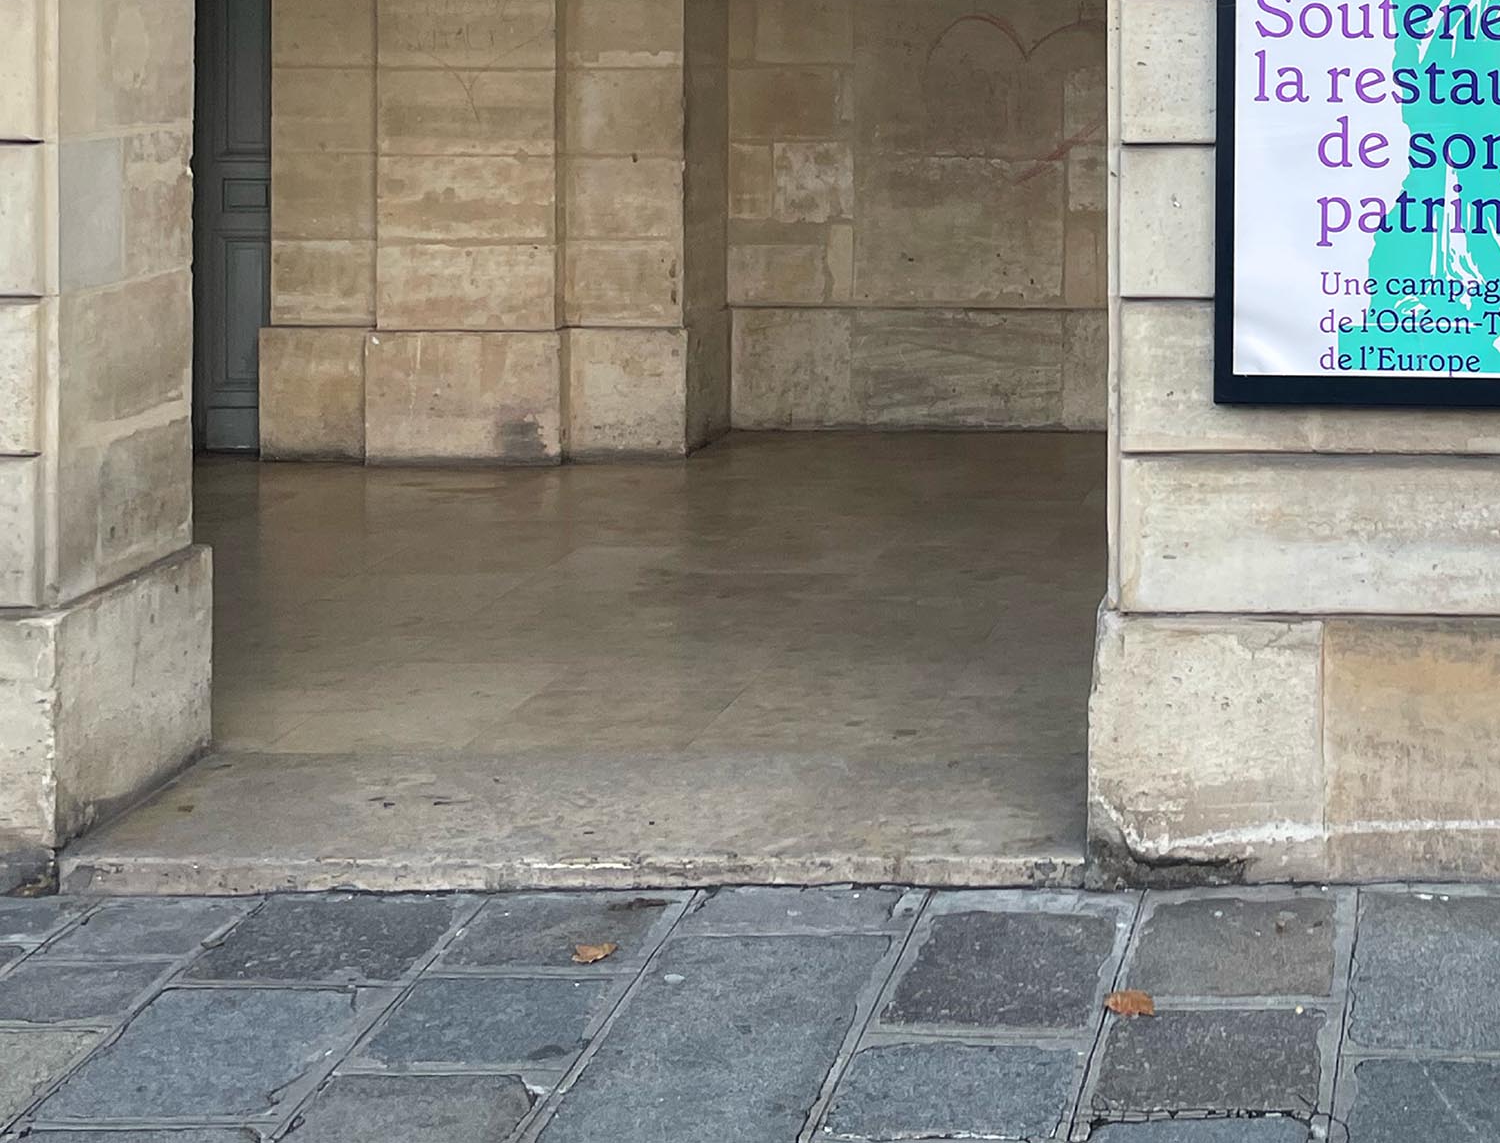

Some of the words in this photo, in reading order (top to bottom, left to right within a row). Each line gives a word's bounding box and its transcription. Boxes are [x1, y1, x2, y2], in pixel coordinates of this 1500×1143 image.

[1254, 50, 1309, 102] la
[1318, 116, 1389, 168] de
[1321, 272, 1378, 295] Une
[1320, 309, 1353, 333] de
[1320, 346, 1352, 370] de
[1360, 346, 1480, 376] l’Europe
